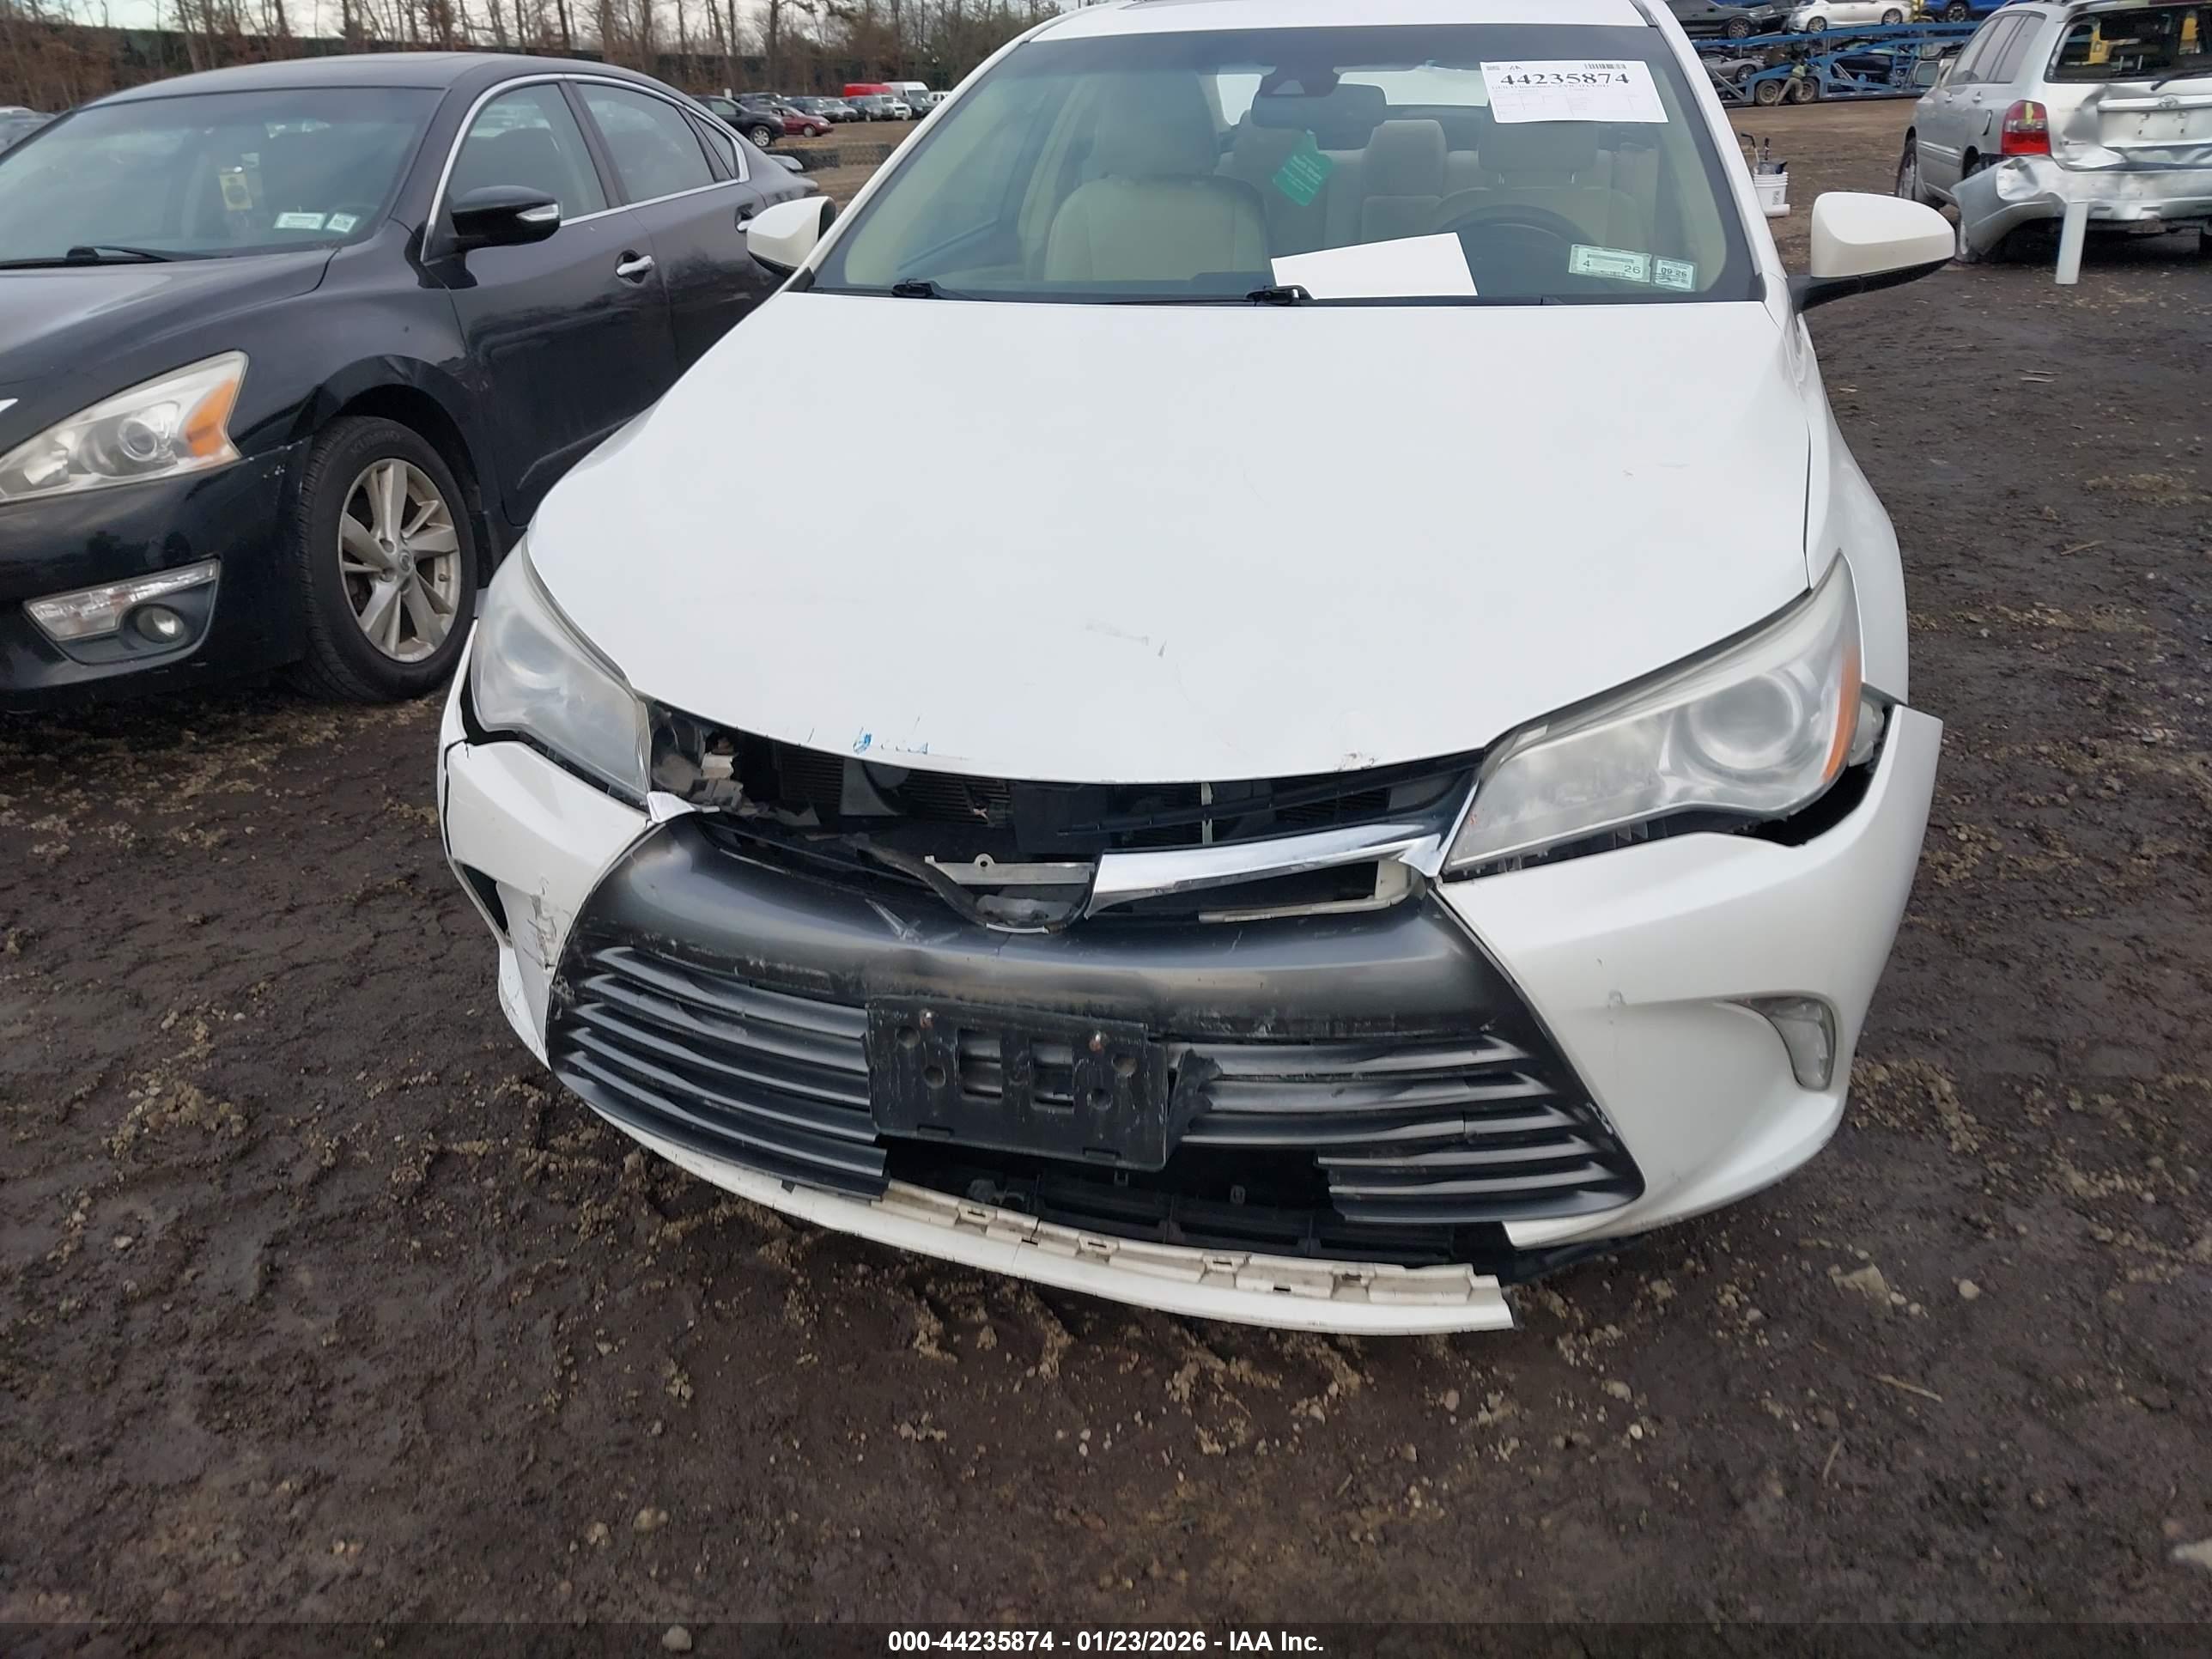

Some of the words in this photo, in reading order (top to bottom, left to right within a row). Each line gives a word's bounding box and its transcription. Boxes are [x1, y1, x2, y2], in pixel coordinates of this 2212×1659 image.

[1500, 73, 1630, 85] 44235874
[1583, 259, 1590, 268] 4
[1624, 264, 1642, 275] 26
